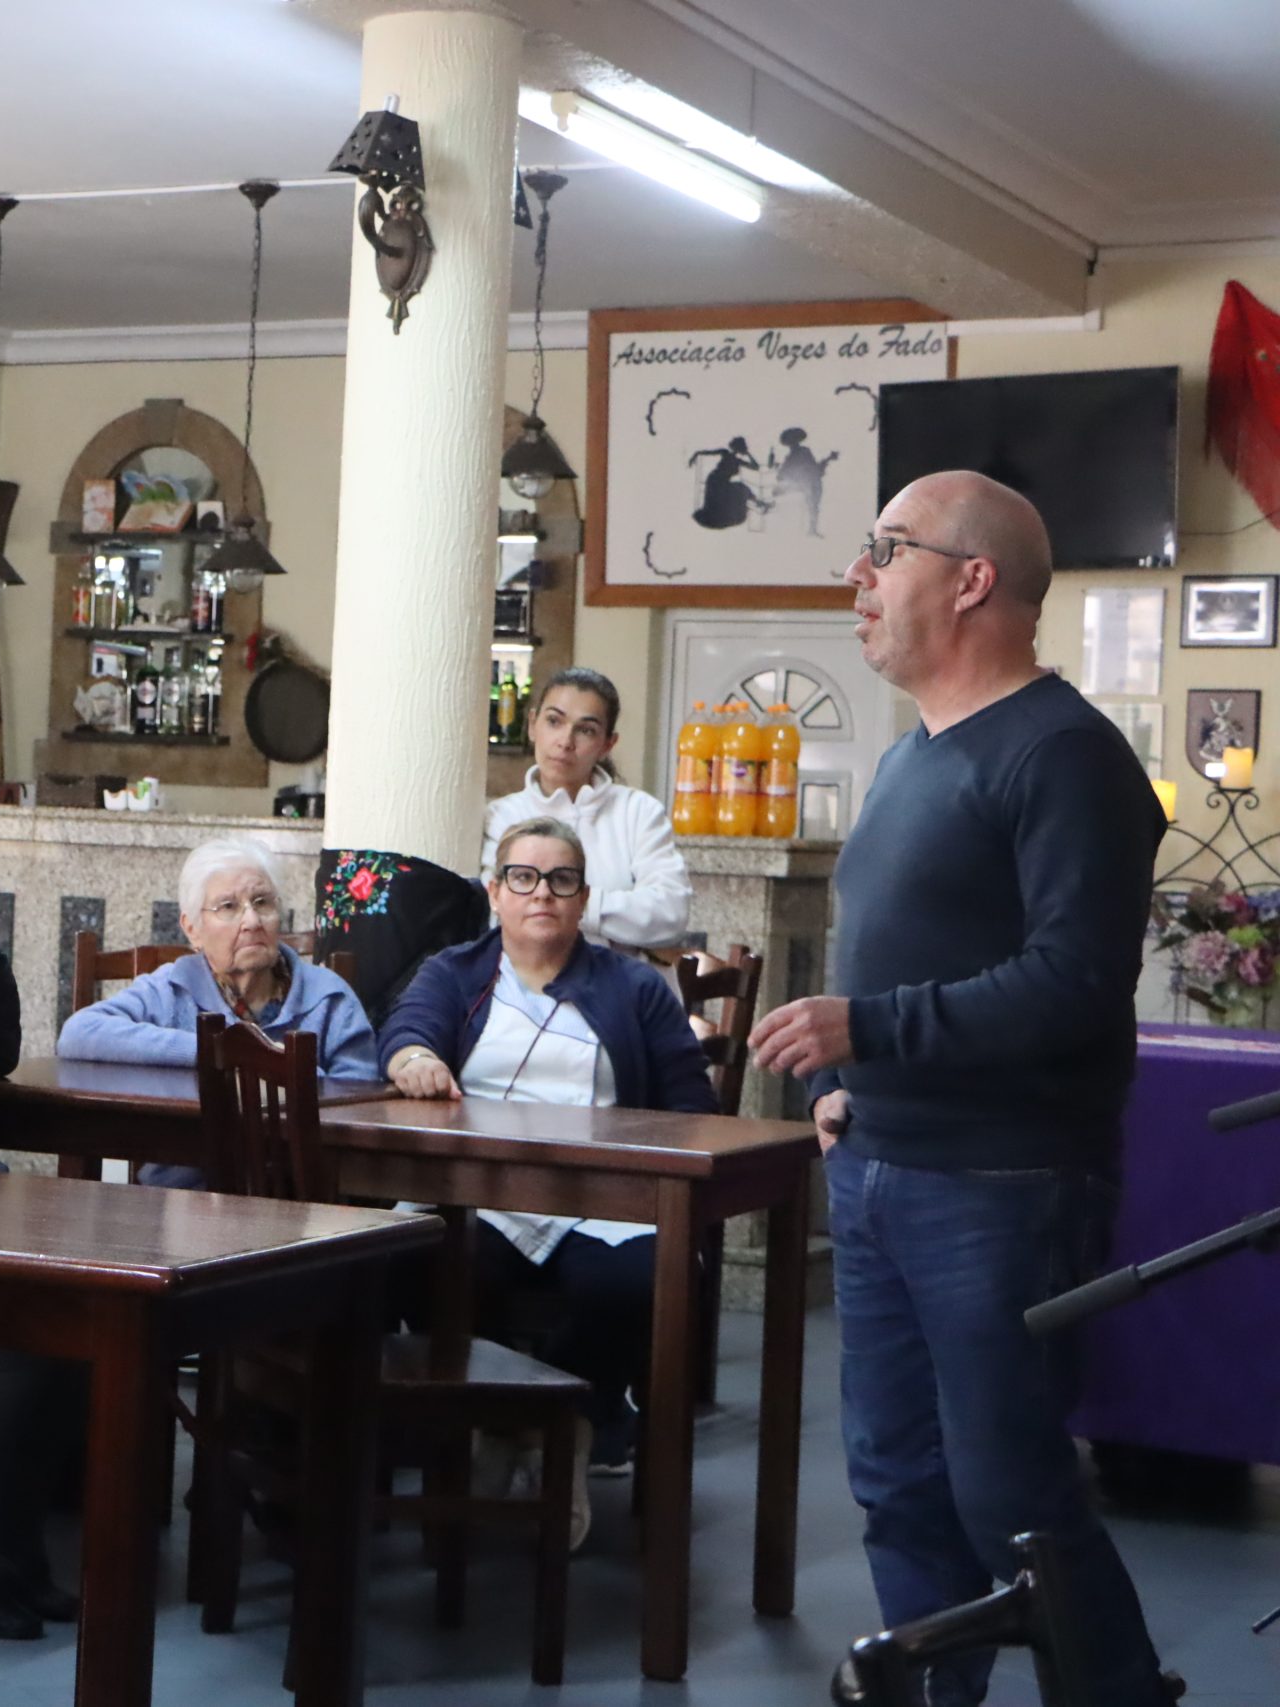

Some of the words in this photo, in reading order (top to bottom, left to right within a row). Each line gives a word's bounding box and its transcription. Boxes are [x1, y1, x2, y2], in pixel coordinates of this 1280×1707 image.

[612, 337, 747, 370] Associação
[757, 329, 827, 369] Vozes
[838, 331, 870, 359] do
[877, 324, 944, 358] Fado
